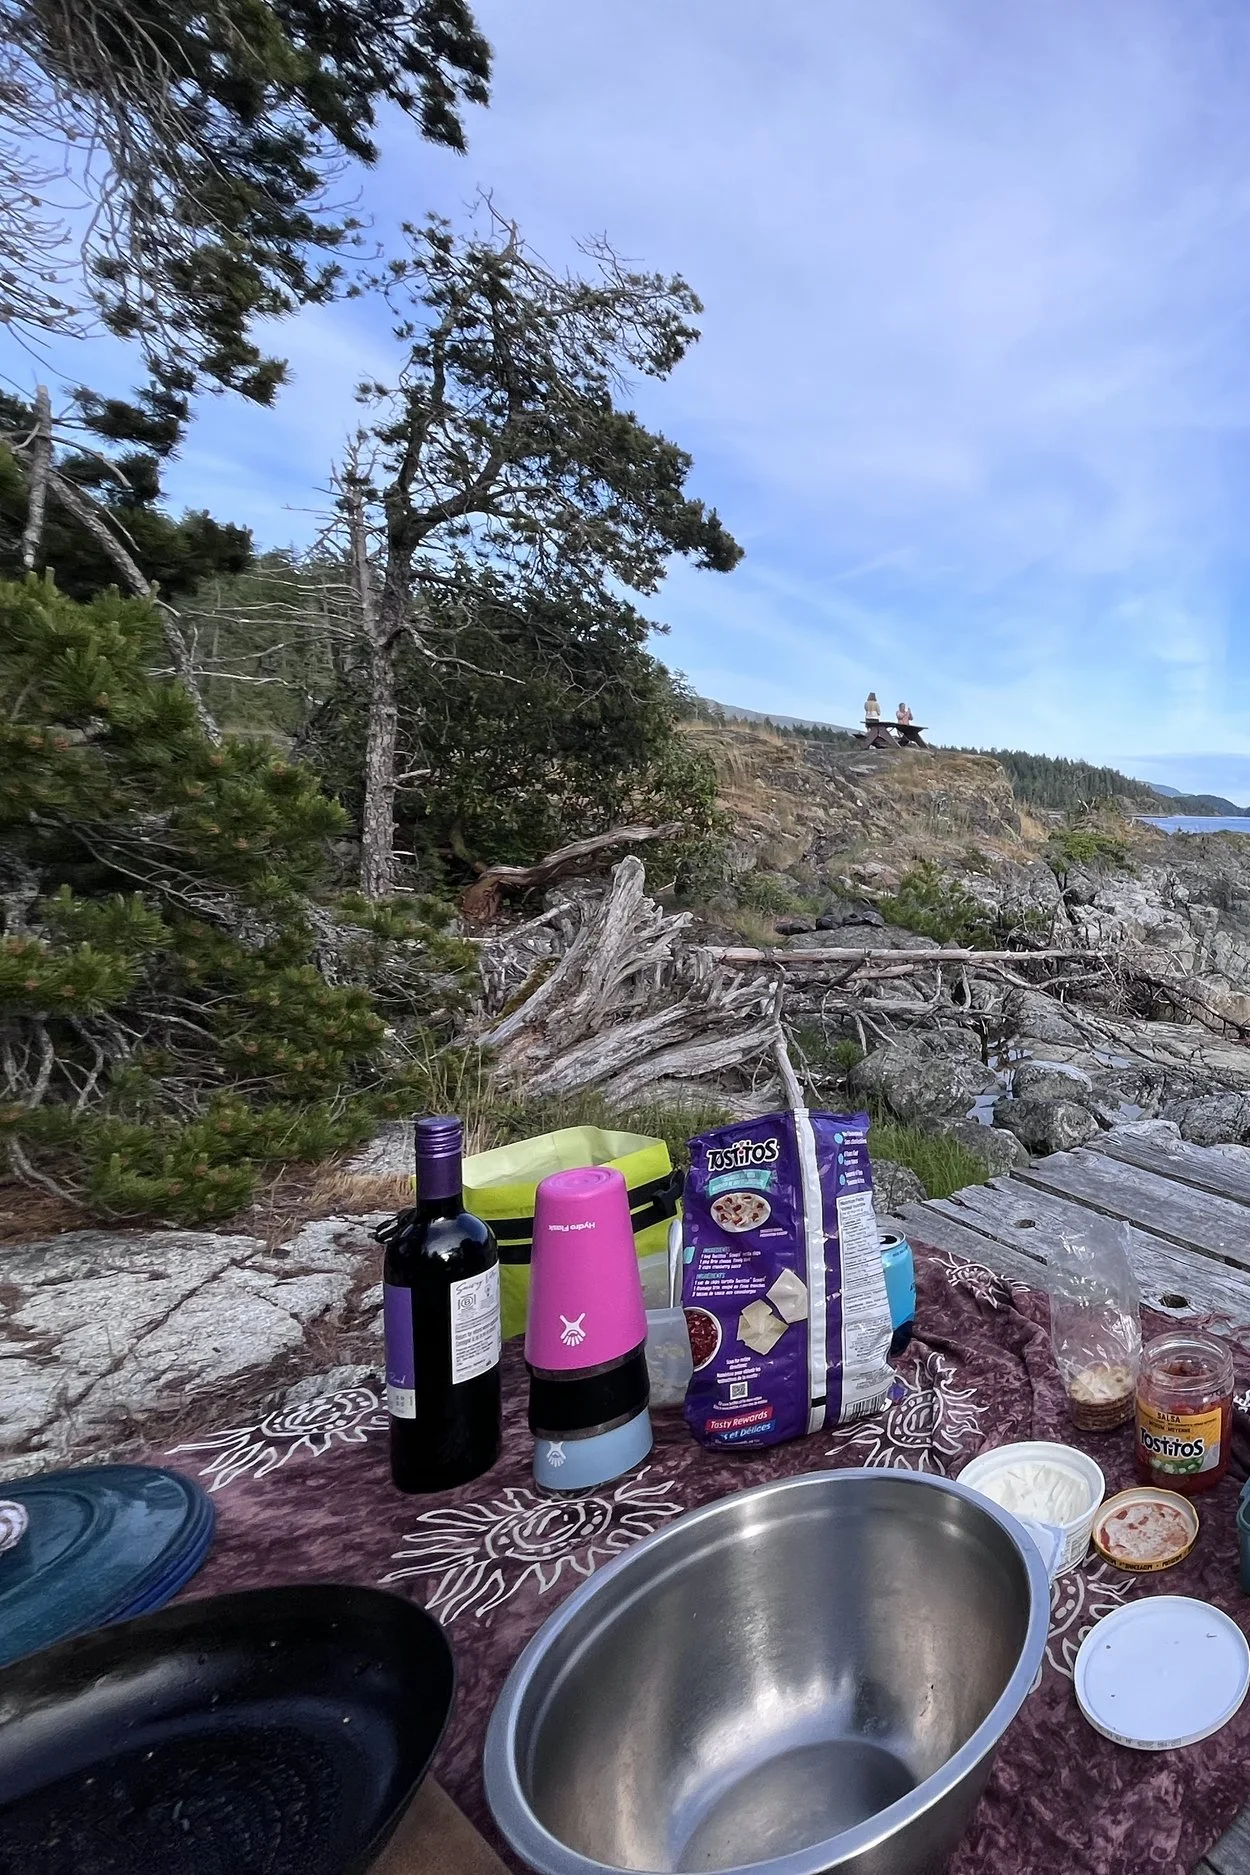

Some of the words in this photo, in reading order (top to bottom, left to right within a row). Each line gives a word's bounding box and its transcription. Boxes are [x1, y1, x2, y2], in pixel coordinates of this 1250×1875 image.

[707, 1139, 778, 1170] TOSTITOS
[570, 1221, 596, 1230] Hydro
[711, 1419, 732, 1429] Tasty
[733, 1410, 768, 1426] Rewards
[1157, 1412, 1181, 1423] SALSA
[729, 1431, 738, 1439] et
[740, 1423, 771, 1437] Délices
[1140, 1426, 1204, 1458] TOSTITOS
